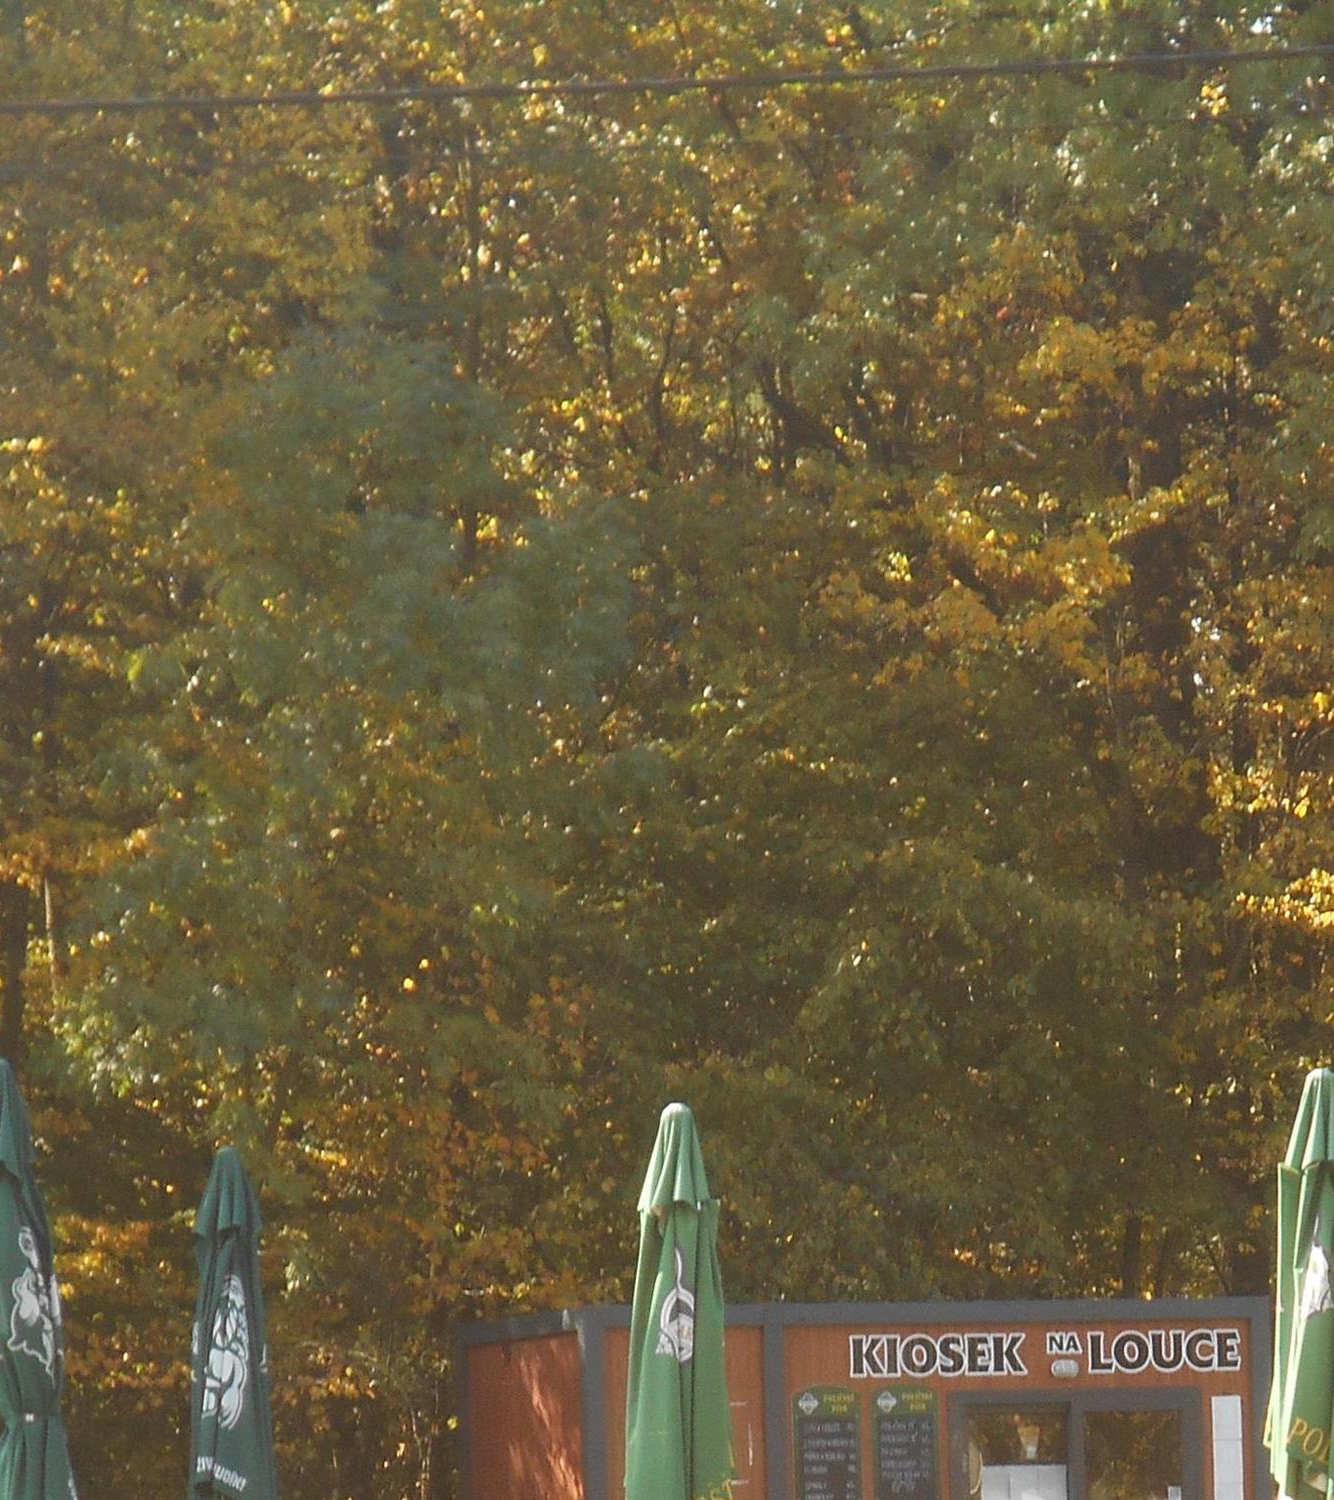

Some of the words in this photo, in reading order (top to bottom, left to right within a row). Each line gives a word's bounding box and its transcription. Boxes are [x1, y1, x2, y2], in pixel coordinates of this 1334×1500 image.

[849, 1333, 1028, 1378] KIOSEK
[1046, 1331, 1082, 1354] NA
[1087, 1328, 1241, 1374] LOUCE
